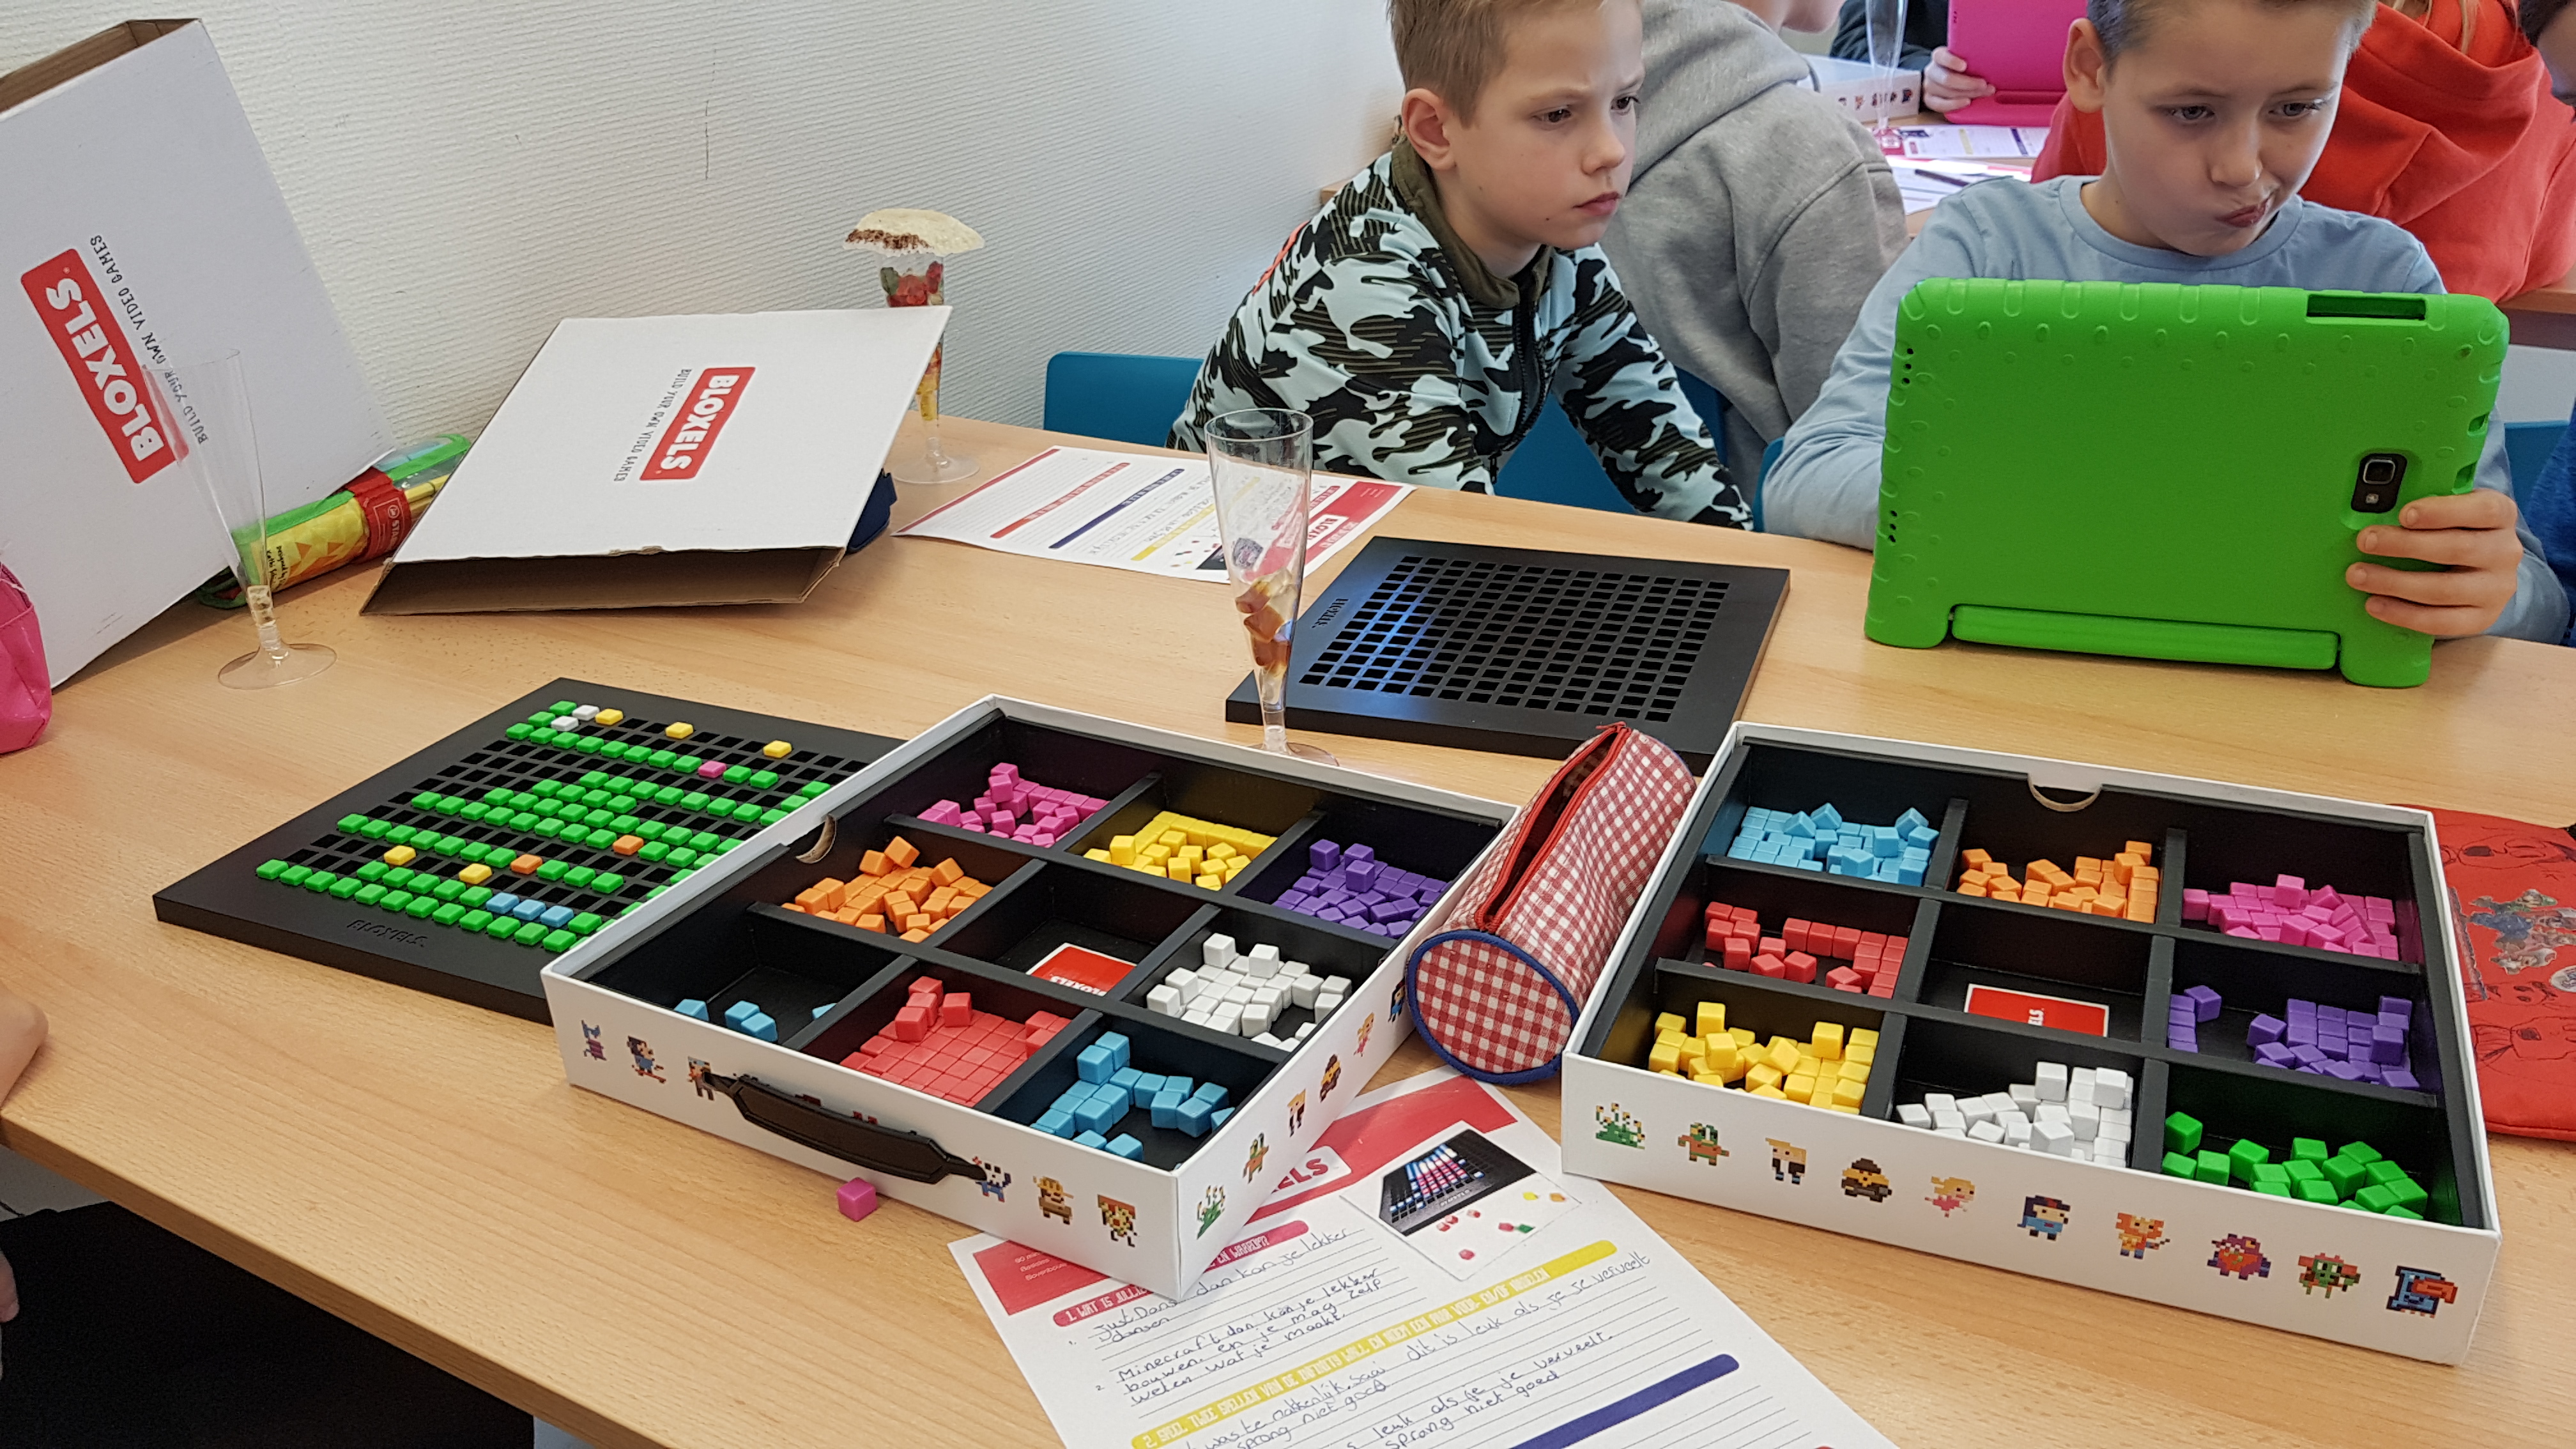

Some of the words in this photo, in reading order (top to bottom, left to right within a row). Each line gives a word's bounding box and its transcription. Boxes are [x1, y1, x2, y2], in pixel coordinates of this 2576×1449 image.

[89, 234, 123, 284] GAMES
[118, 286, 146, 330] VIDEO
[141, 332, 165, 365] OWN
[46, 279, 164, 461] BLOXELS
[164, 368, 188, 403] YOUR
[671, 368, 692, 388] BUILD
[657, 390, 677, 410] YOUR
[183, 405, 208, 445] BUILD
[646, 411, 665, 427] OWN
[660, 374, 740, 471] BLOXELS
[631, 431, 654, 452] VIDEO
[614, 456, 638, 482] GAMES
[1076, 1300, 1100, 1319] WAT
[1100, 1294, 1114, 1310] IS
